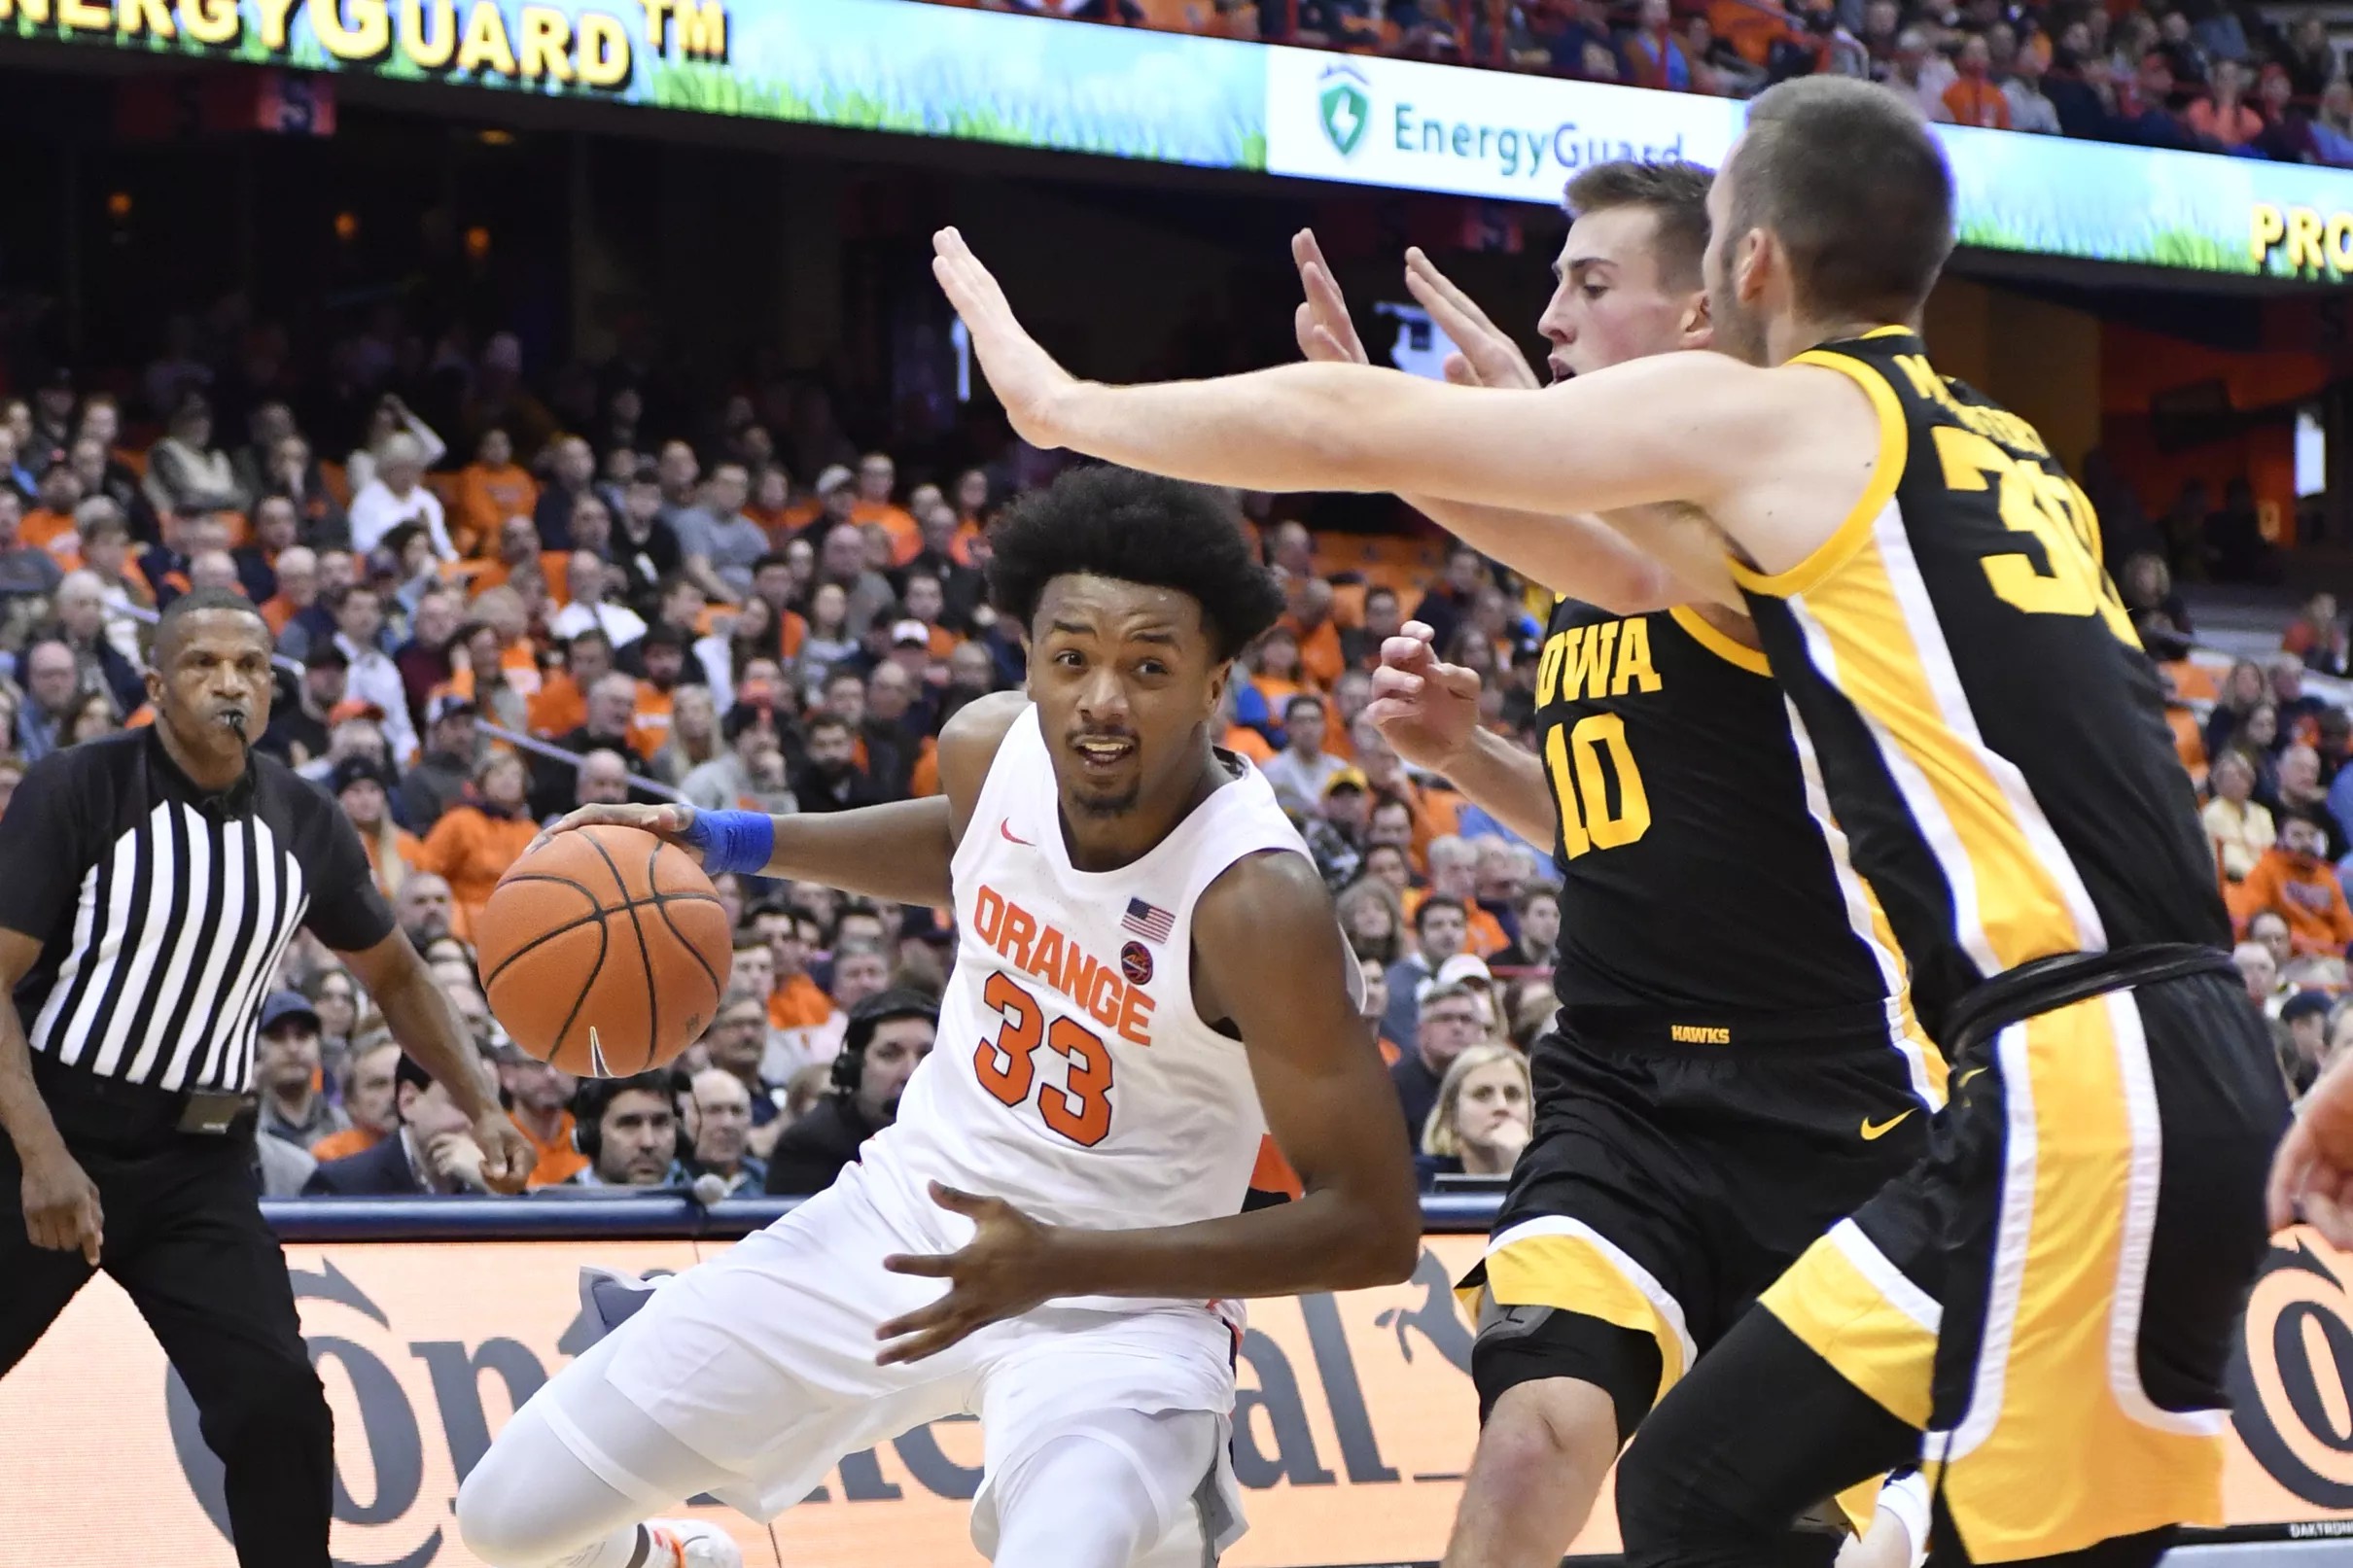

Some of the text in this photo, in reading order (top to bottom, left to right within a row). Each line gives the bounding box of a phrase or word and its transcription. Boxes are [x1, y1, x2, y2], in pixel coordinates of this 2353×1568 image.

[1534, 616, 1663, 714] OWA
[1545, 712, 1652, 860] 10
[973, 884, 1156, 1047] ORANGE
[1670, 1024, 1731, 1045] HAWKS
[973, 969, 1113, 1148] 33
